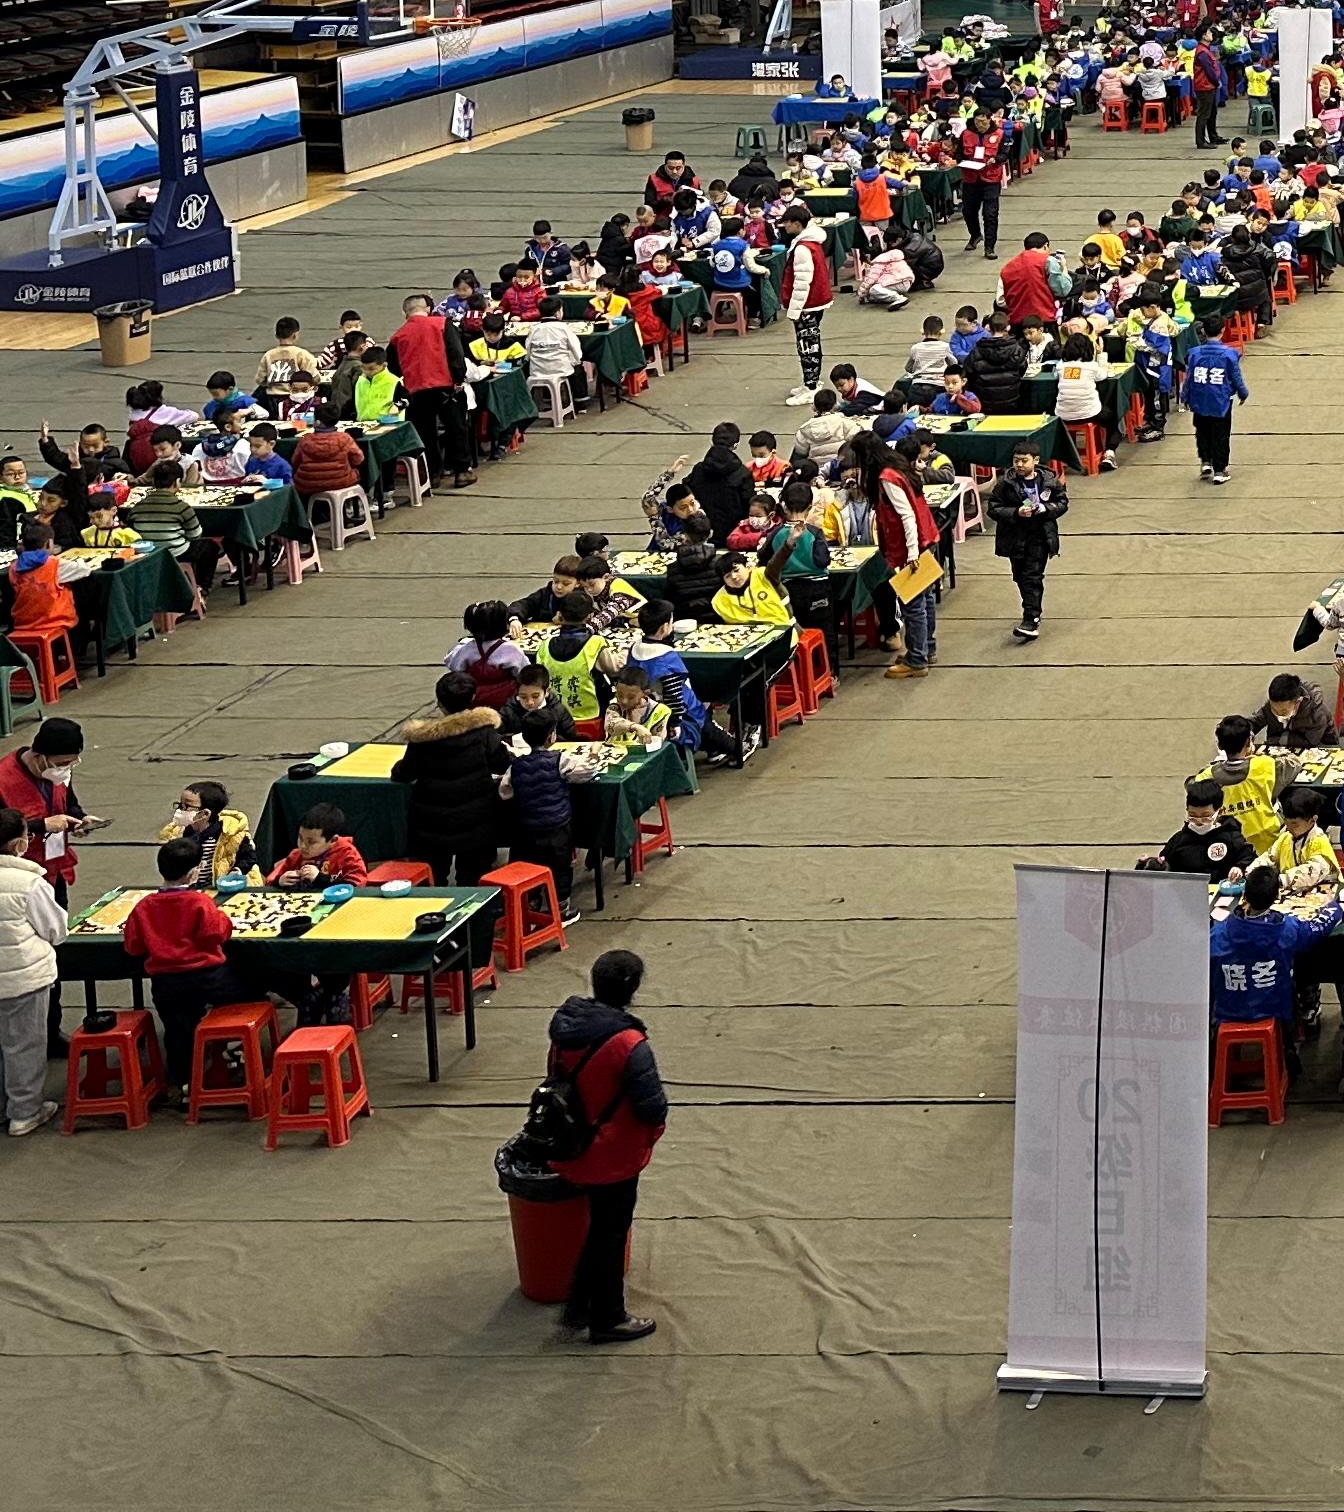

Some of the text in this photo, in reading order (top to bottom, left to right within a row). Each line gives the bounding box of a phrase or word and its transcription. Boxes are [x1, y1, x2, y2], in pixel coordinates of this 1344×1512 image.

[179, 86, 198, 176] 金陵体育
[1221, 960, 1277, 992] 晓冬
